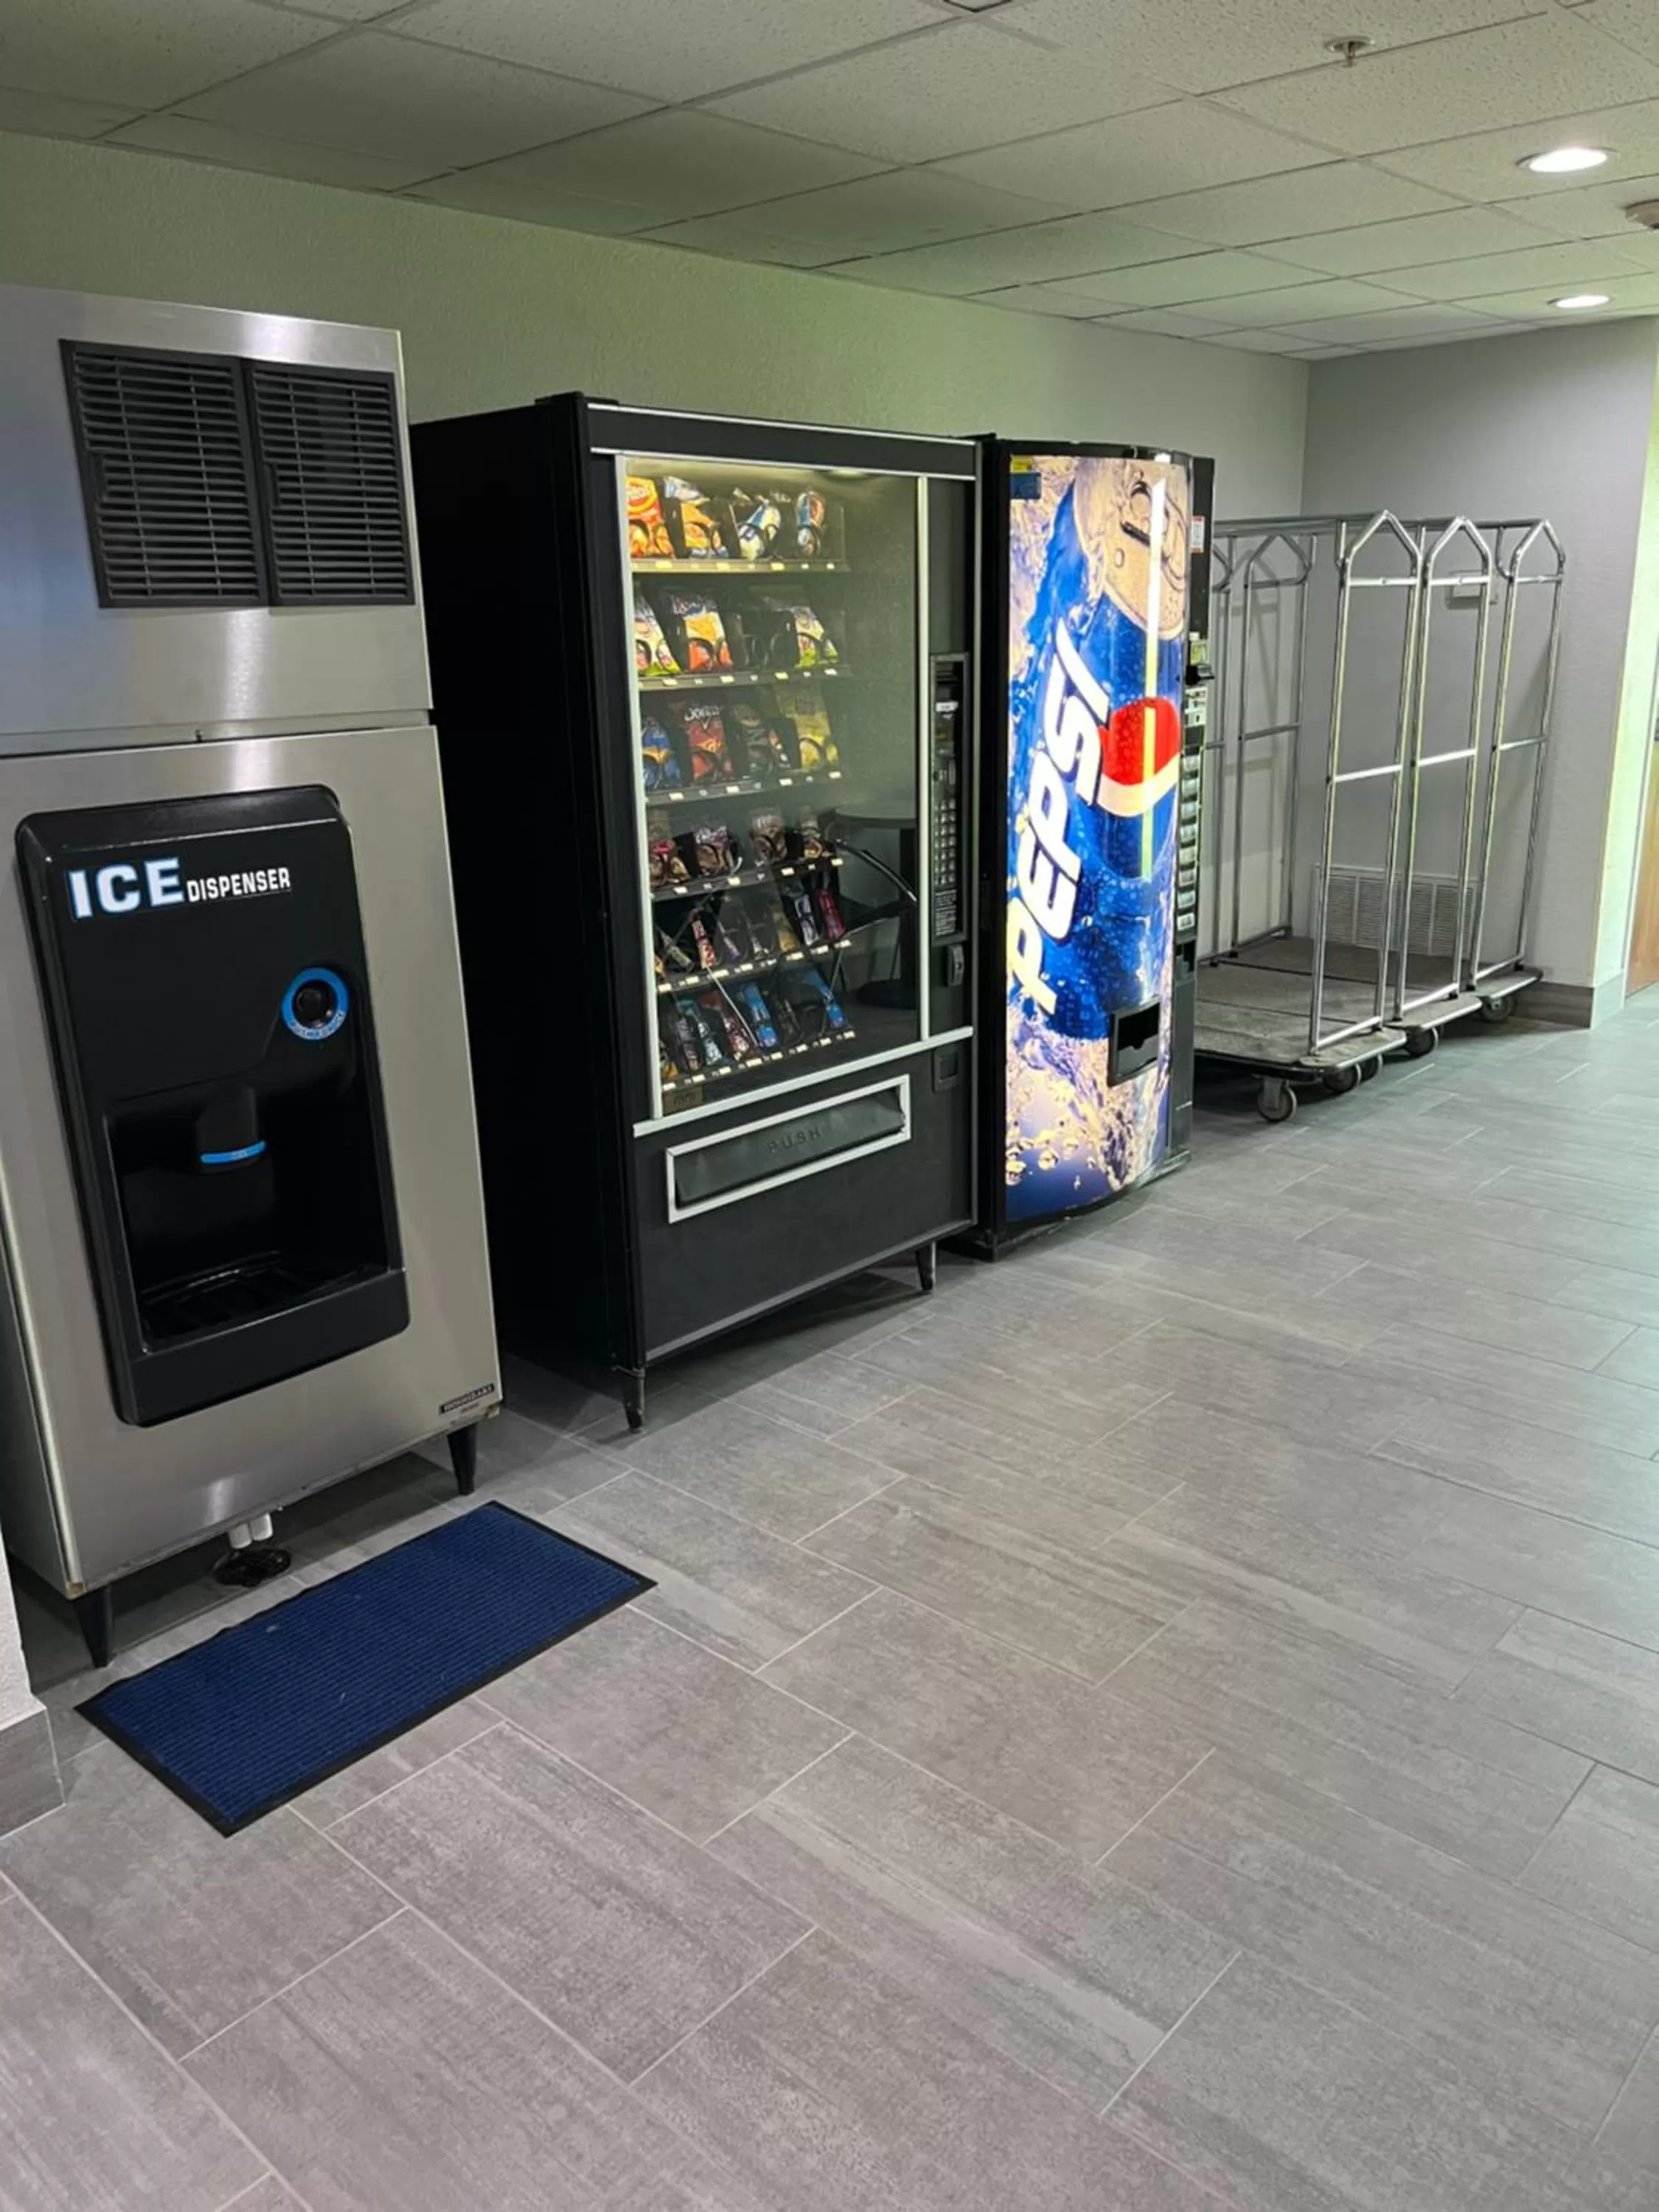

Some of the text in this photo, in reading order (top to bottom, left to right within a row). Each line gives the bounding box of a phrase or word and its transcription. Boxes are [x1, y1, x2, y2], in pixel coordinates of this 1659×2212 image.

[1009, 618, 1110, 1015] PEPSI
[69, 858, 291, 919] ICE DISPENSER
[767, 1126, 821, 1154] PUSH
